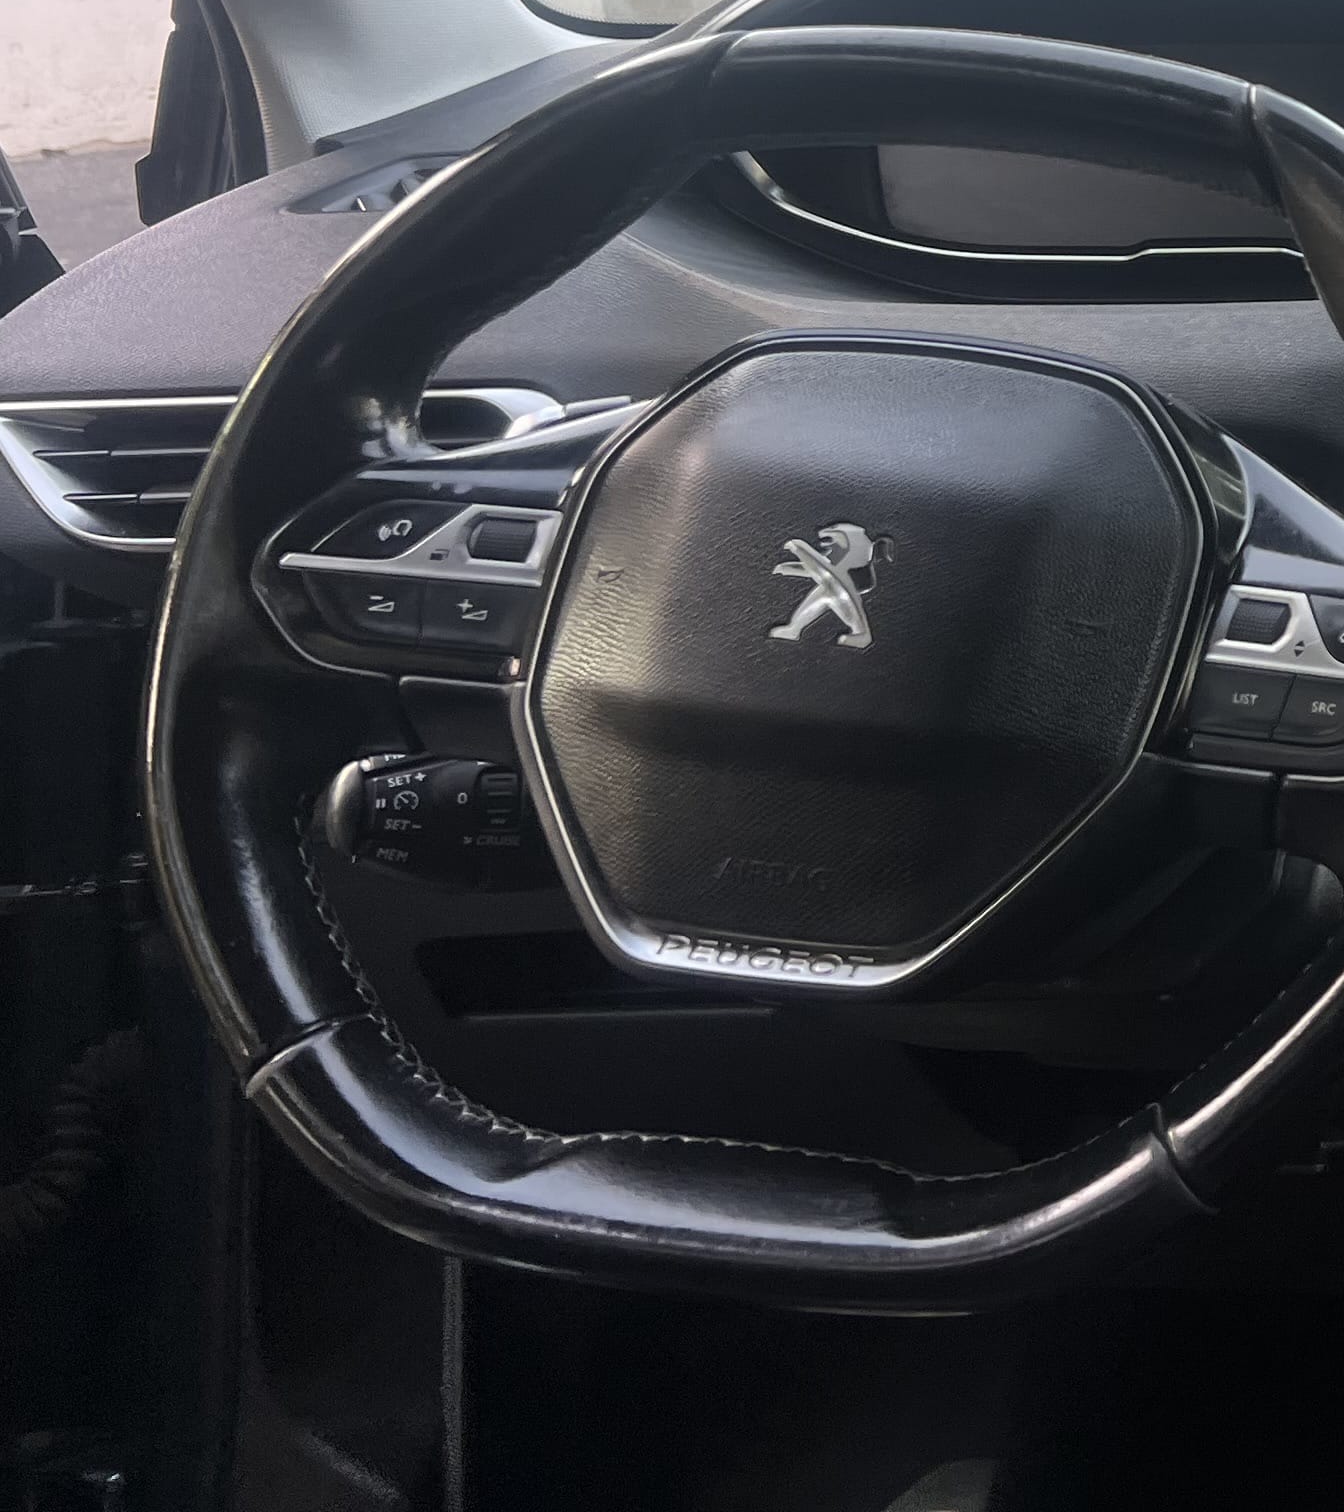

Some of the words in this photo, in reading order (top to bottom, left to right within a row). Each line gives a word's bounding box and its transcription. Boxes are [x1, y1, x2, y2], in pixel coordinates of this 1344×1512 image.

[1232, 692, 1259, 707] LIST
[1311, 700, 1337, 716] SRC
[376, 847, 409, 863] MEM
[655, 934, 876, 978] PEUGEOT
